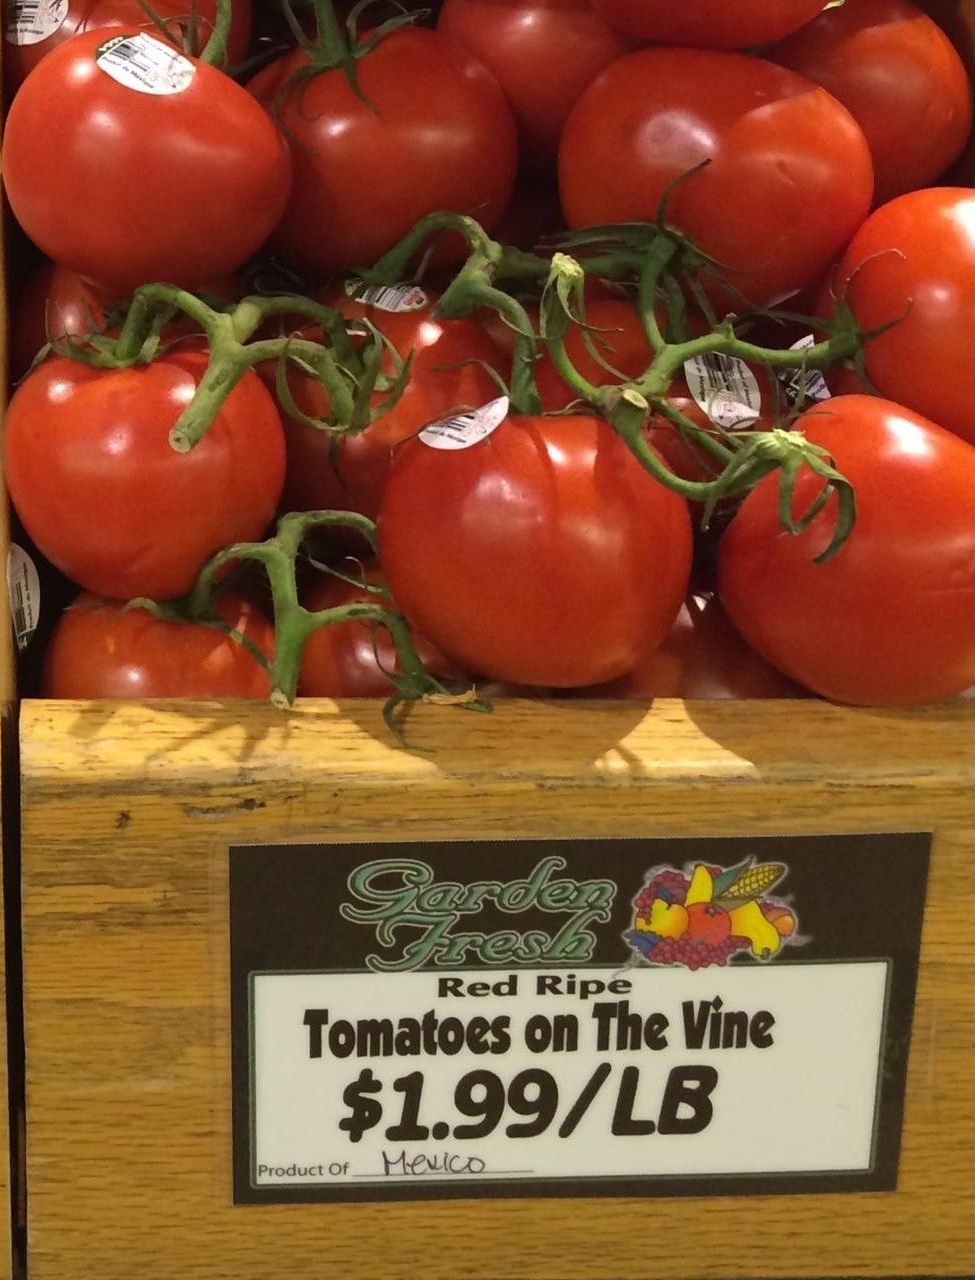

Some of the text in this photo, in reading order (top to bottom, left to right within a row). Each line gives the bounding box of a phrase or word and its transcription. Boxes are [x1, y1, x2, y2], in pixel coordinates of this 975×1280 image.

[339, 856, 618, 924] Garden
[365, 907, 612, 973] Fresh
[438, 974, 633, 1000] Red Ripe
[303, 995, 776, 1059] Tomatoes on The Vine
[338, 1062, 719, 1143] $1.99/LB
[258, 1162, 349, 1177] Product Of
[382, 1150, 486, 1176] Mexico
